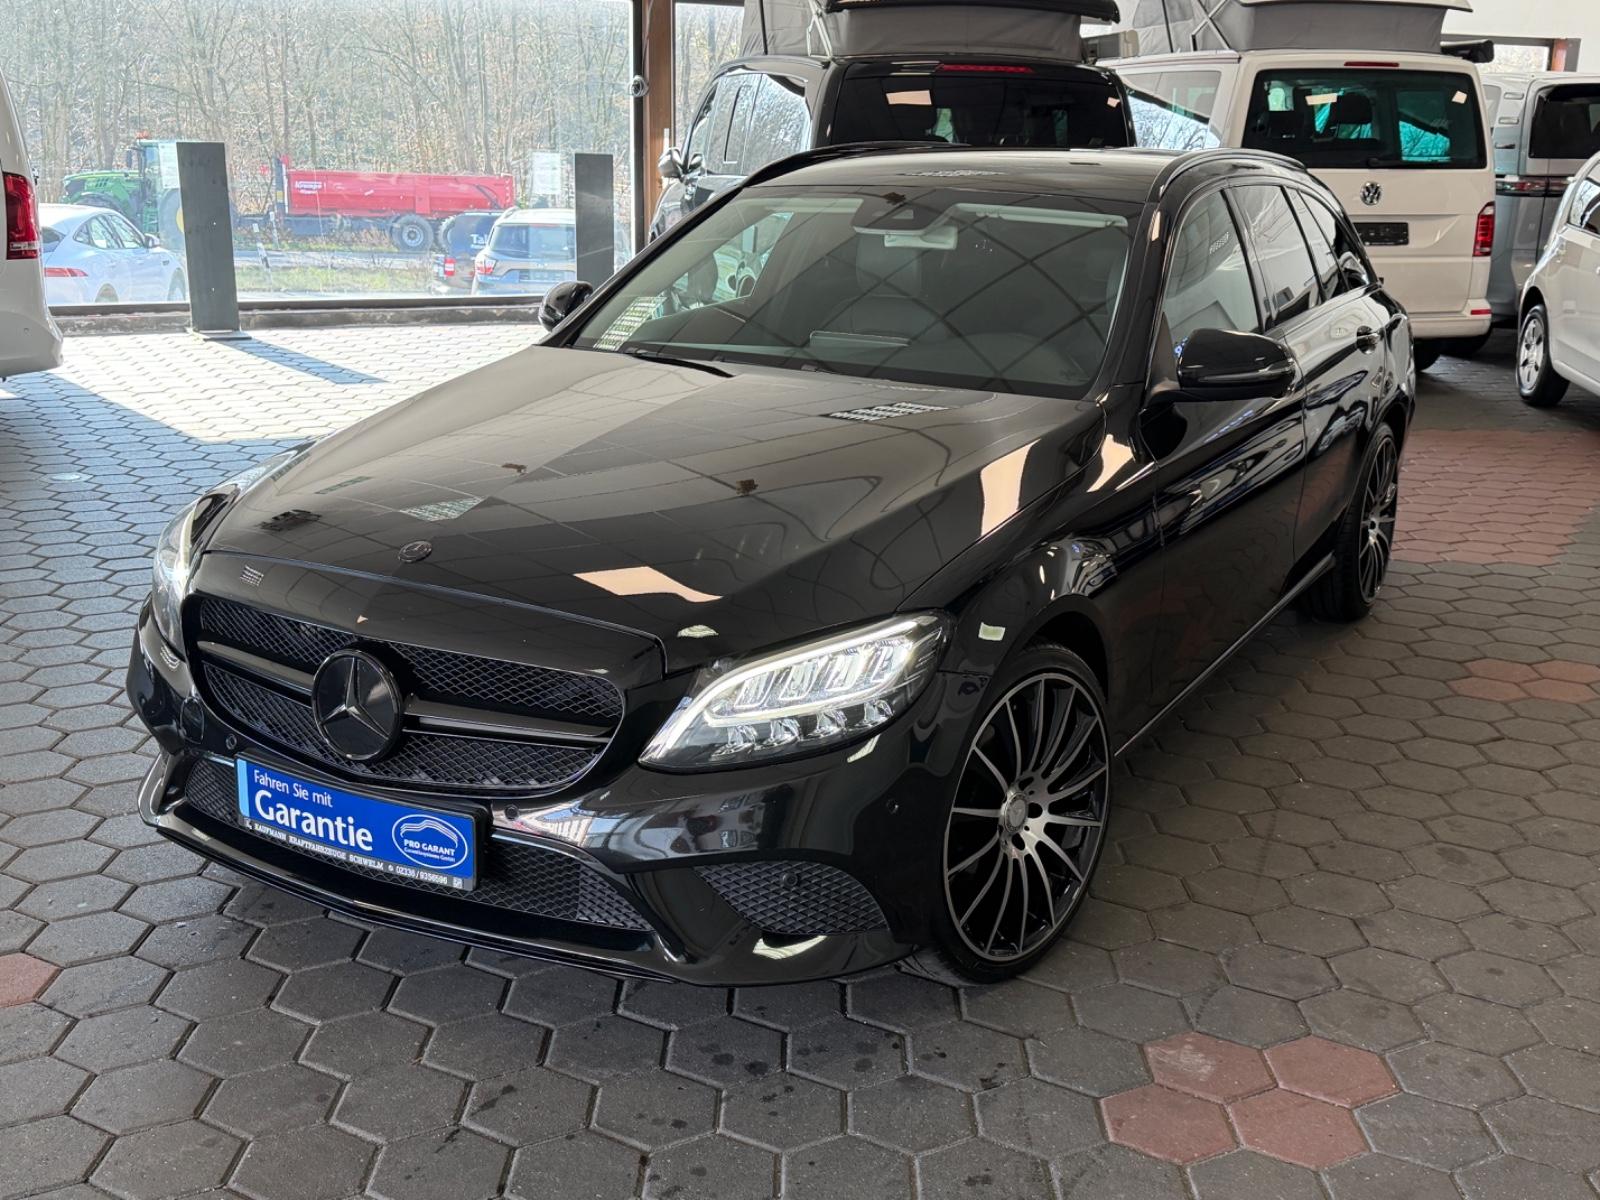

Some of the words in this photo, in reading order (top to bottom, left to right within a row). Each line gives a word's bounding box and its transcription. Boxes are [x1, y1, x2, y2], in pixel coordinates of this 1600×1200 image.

[253, 770, 290, 794] Fahren
[292, 782, 309, 800] Sie
[312, 791, 333, 808] mit
[255, 789, 373, 851] Garantie
[403, 839, 420, 849] PRO
[421, 842, 456, 856] GARANT
[349, 854, 384, 870] SCHWELM
